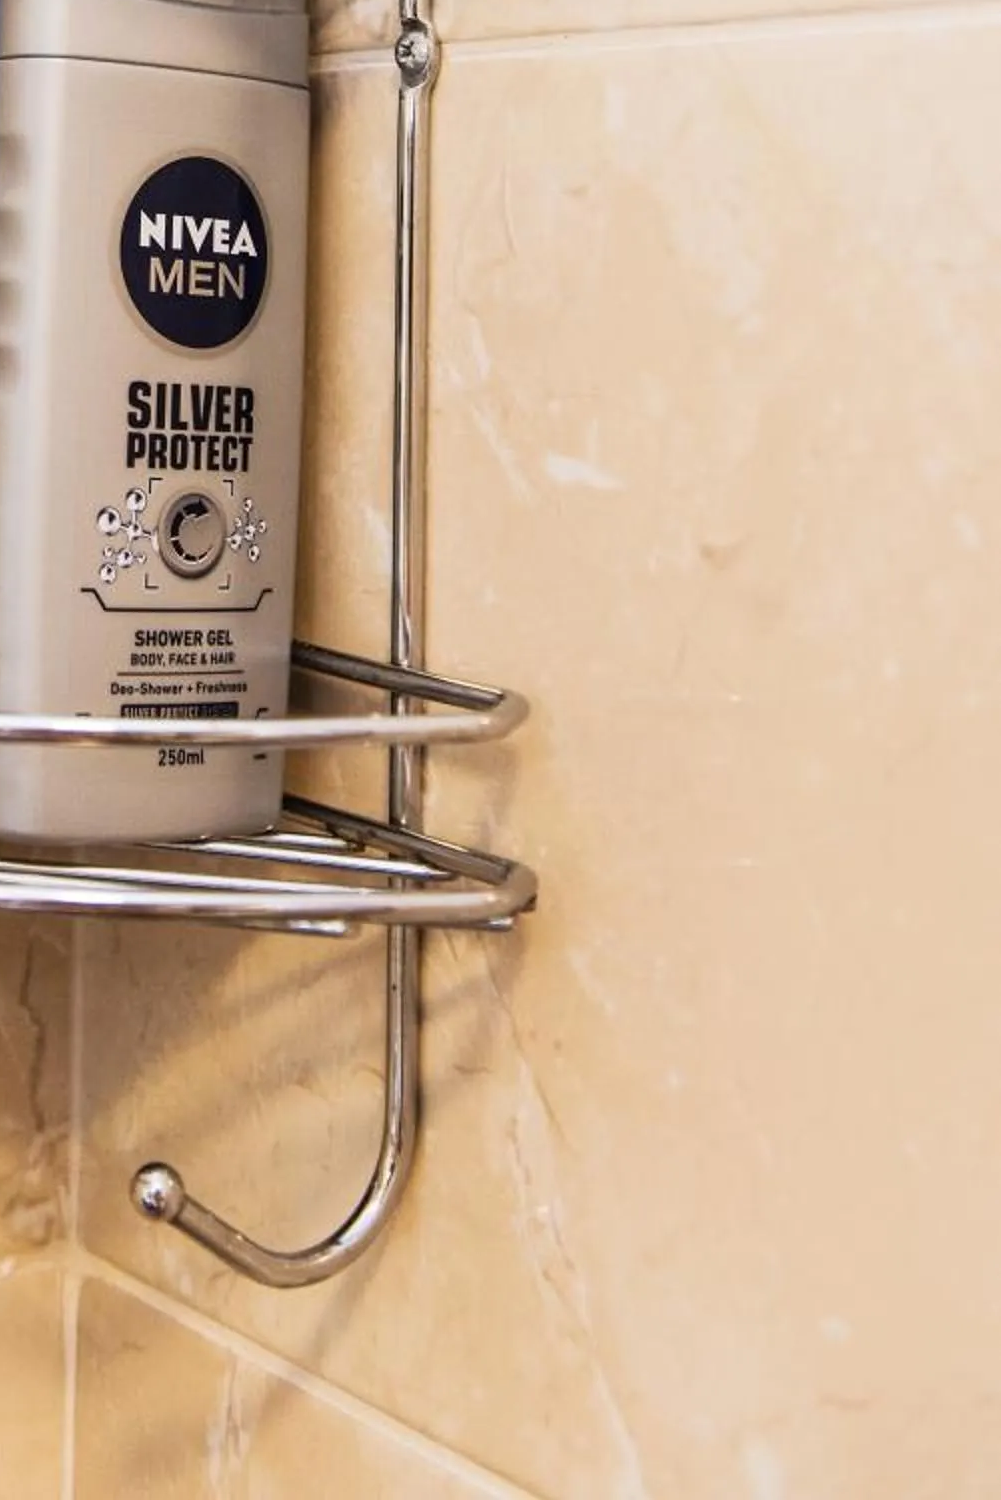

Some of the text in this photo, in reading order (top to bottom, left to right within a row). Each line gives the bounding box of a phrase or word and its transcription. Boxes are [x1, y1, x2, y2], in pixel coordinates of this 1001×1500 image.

[138, 210, 258, 257] NIVEA
[149, 257, 245, 300] MEN
[127, 380, 255, 434] SILVER
[126, 431, 253, 473] PROTECT
[134, 629, 233, 647] SHOWER GEL
[130, 652, 236, 667] BODY, FACE & HAIR
[110, 682, 183, 695] Deo-Shower
[196, 680, 247, 694] Freshness
[158, 749, 205, 767] 250ml
